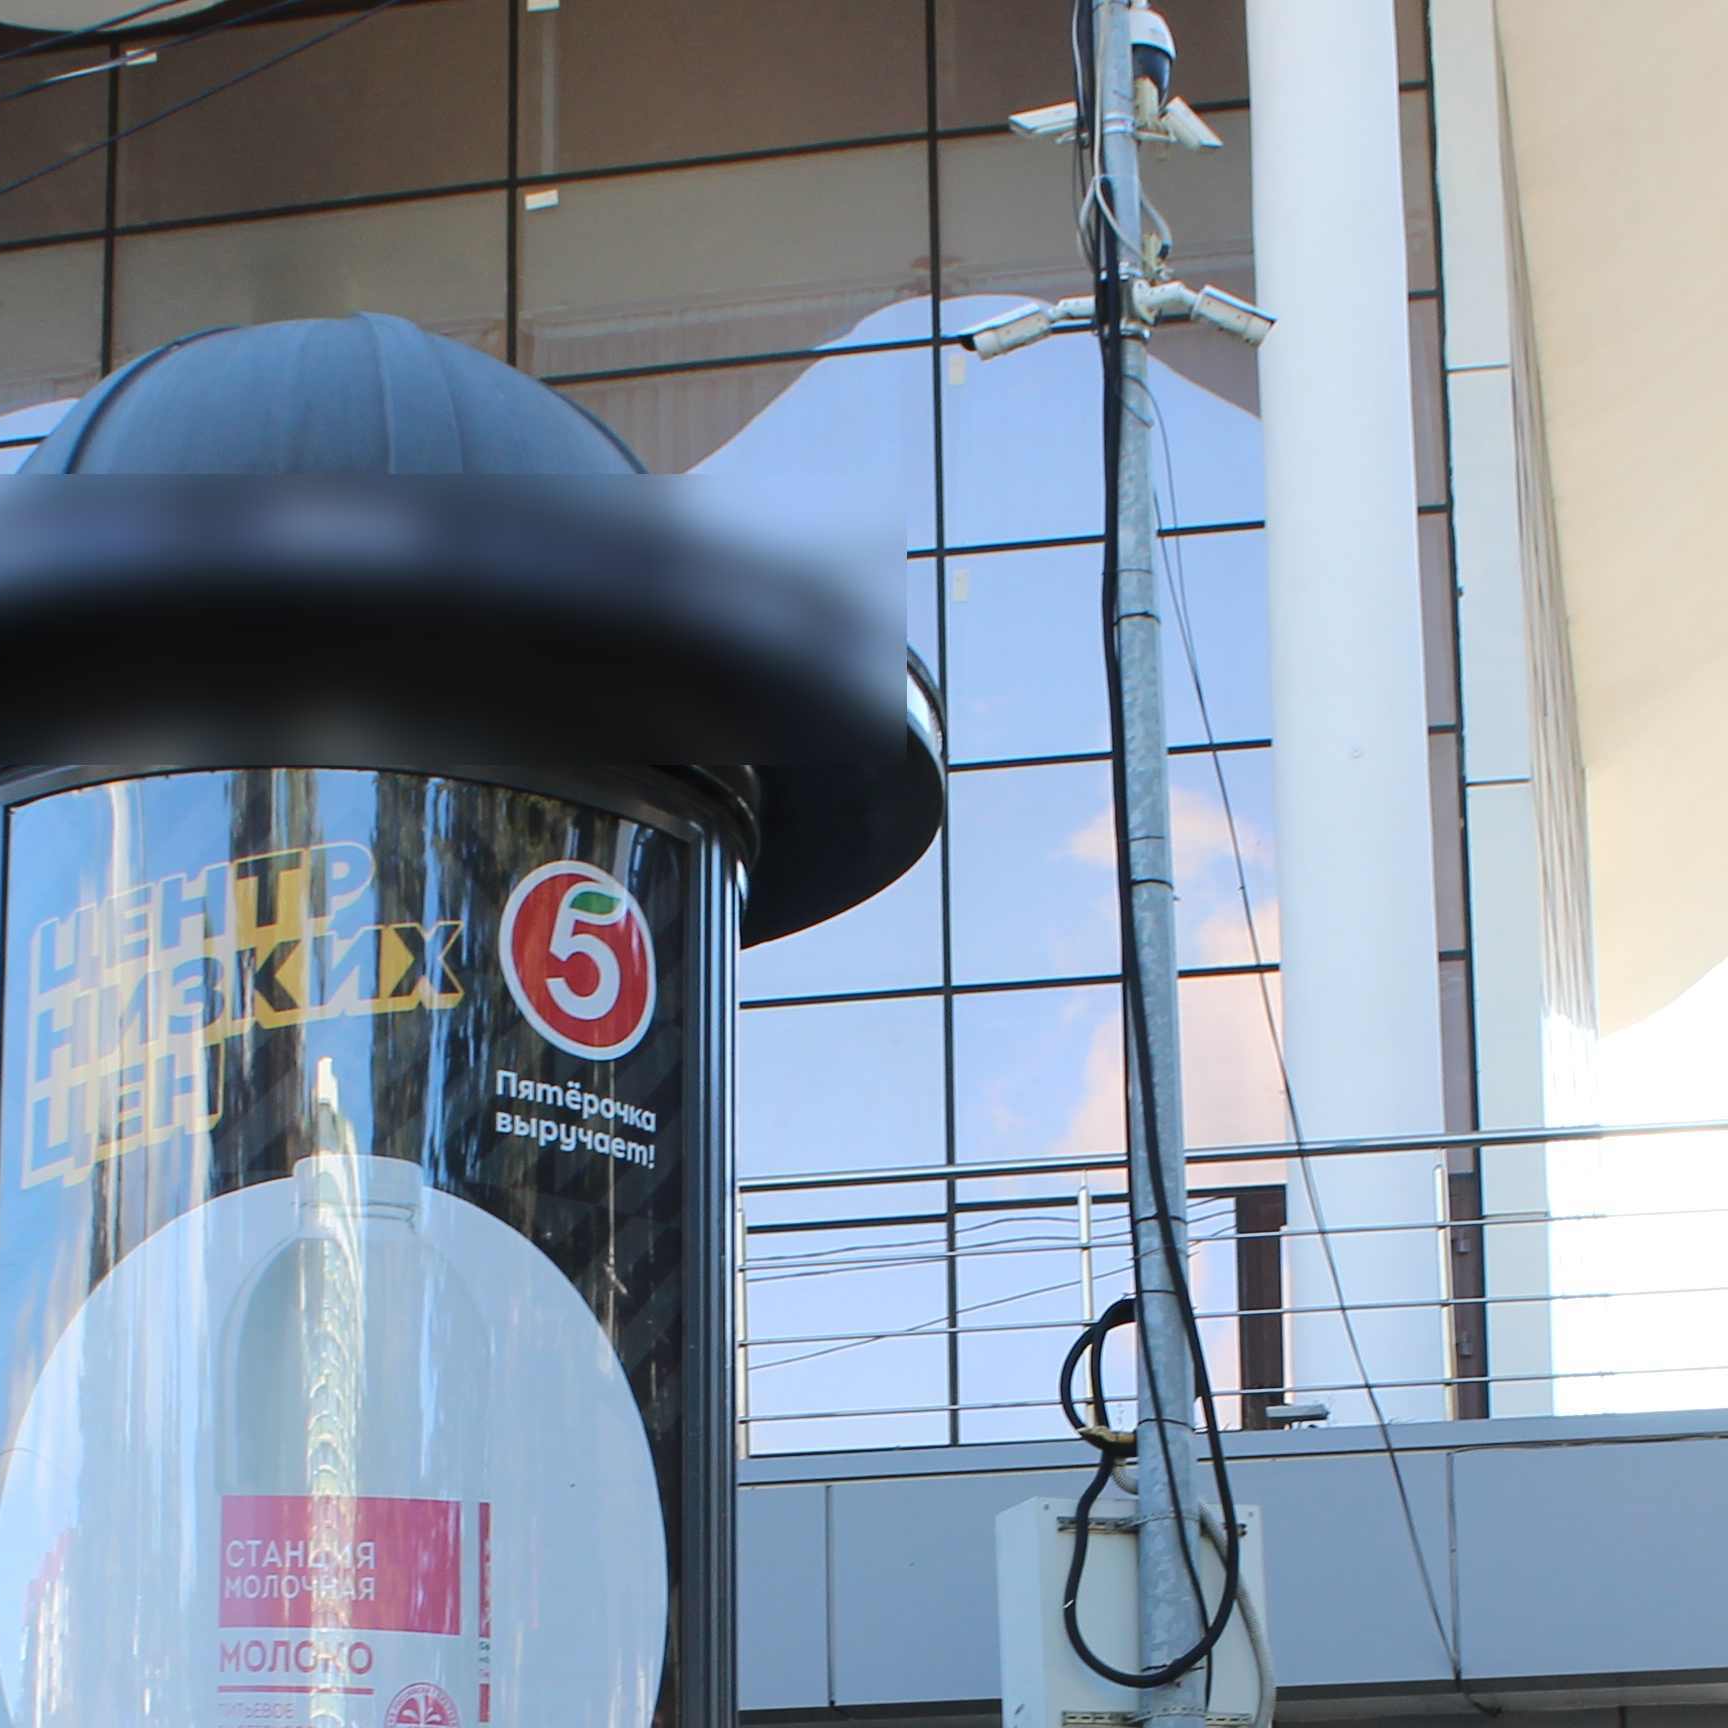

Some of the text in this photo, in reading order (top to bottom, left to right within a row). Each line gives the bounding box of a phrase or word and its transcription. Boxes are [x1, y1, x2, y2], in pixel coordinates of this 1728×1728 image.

[28, 841, 375, 995] ЦЕНТР
[30, 921, 464, 1066] НИЗКИХ
[21, 1038, 224, 1189] ЦЕН
[496, 1070, 656, 1131] Пятёрочка
[496, 1111, 656, 1170] выручает!
